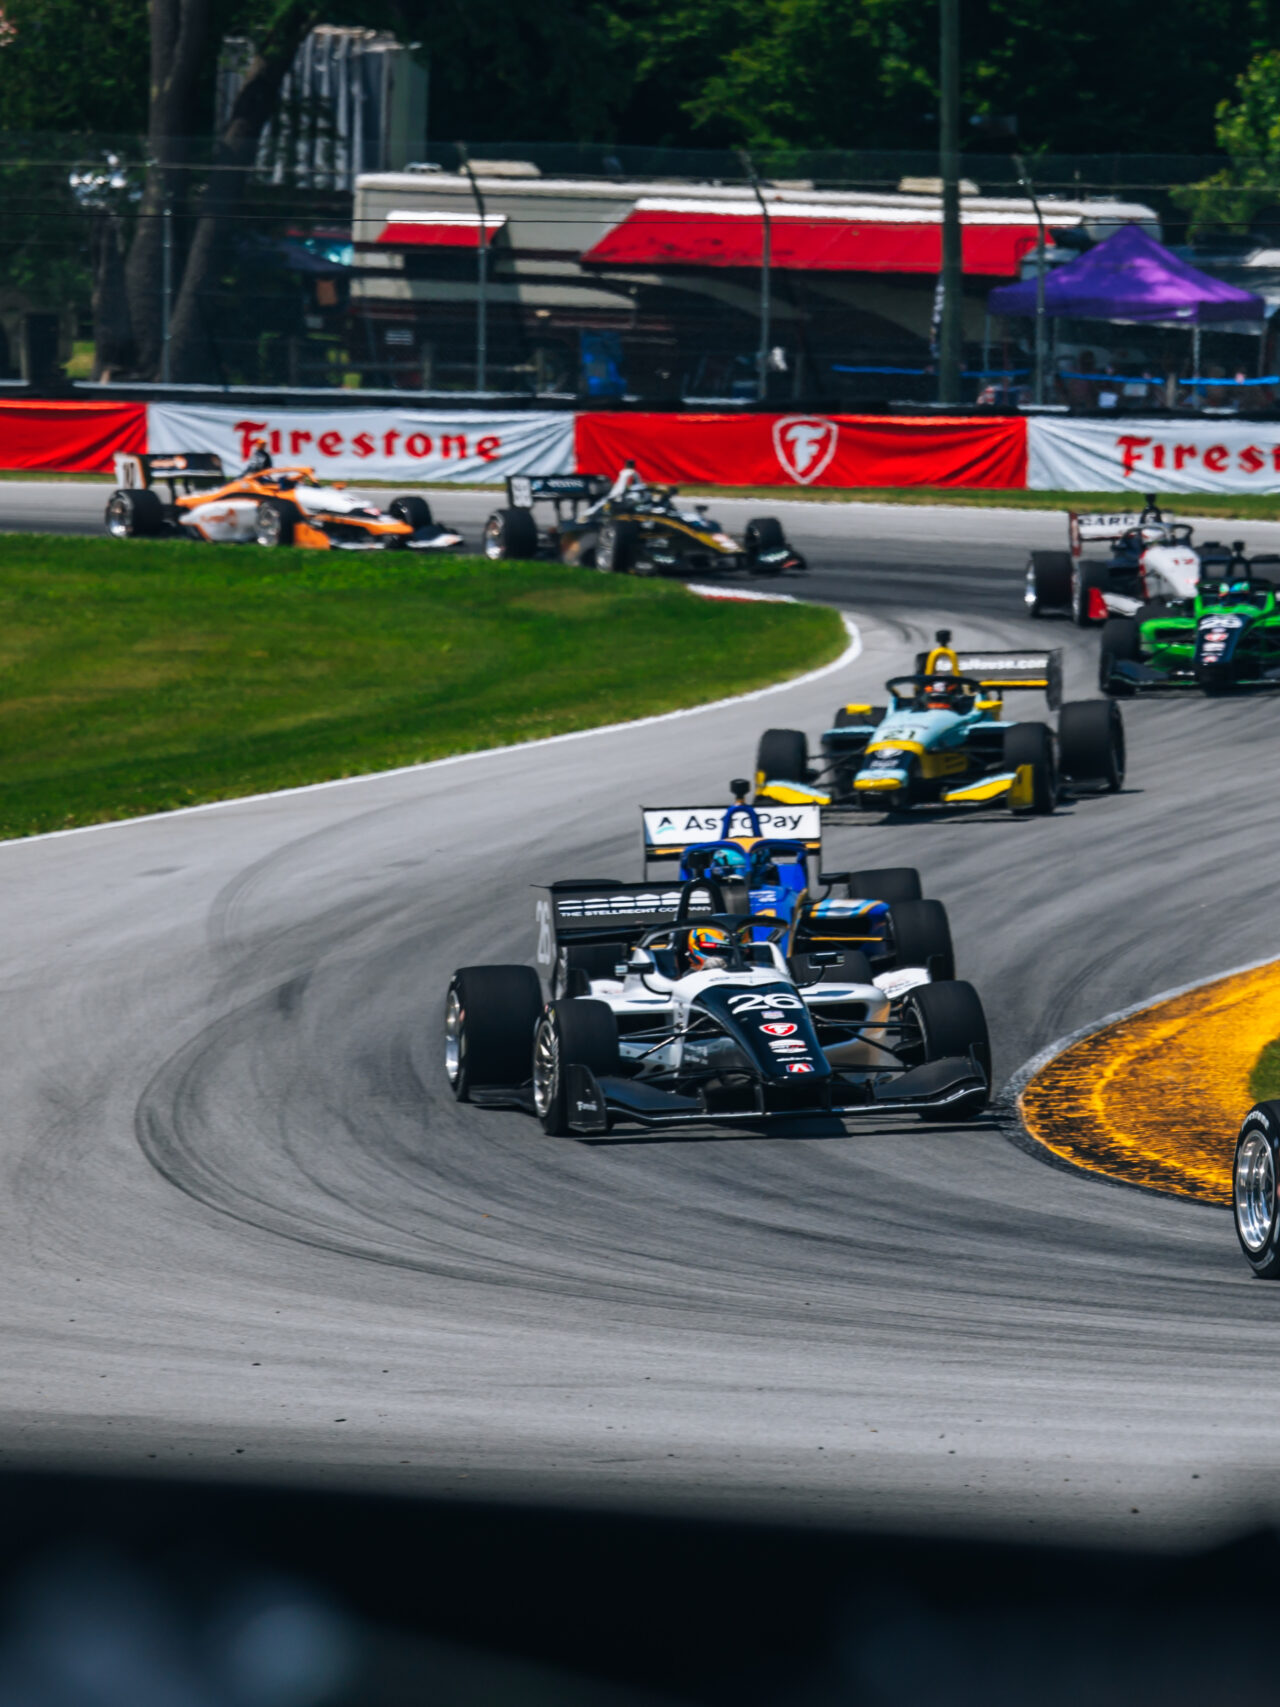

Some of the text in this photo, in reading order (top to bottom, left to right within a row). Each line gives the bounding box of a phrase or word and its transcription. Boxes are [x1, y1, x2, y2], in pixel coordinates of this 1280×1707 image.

[234, 421, 501, 462] Firestone
[684, 813, 803, 831] AsroPay
[658, 905, 711, 913] COMANY
[727, 993, 804, 1014] 26
